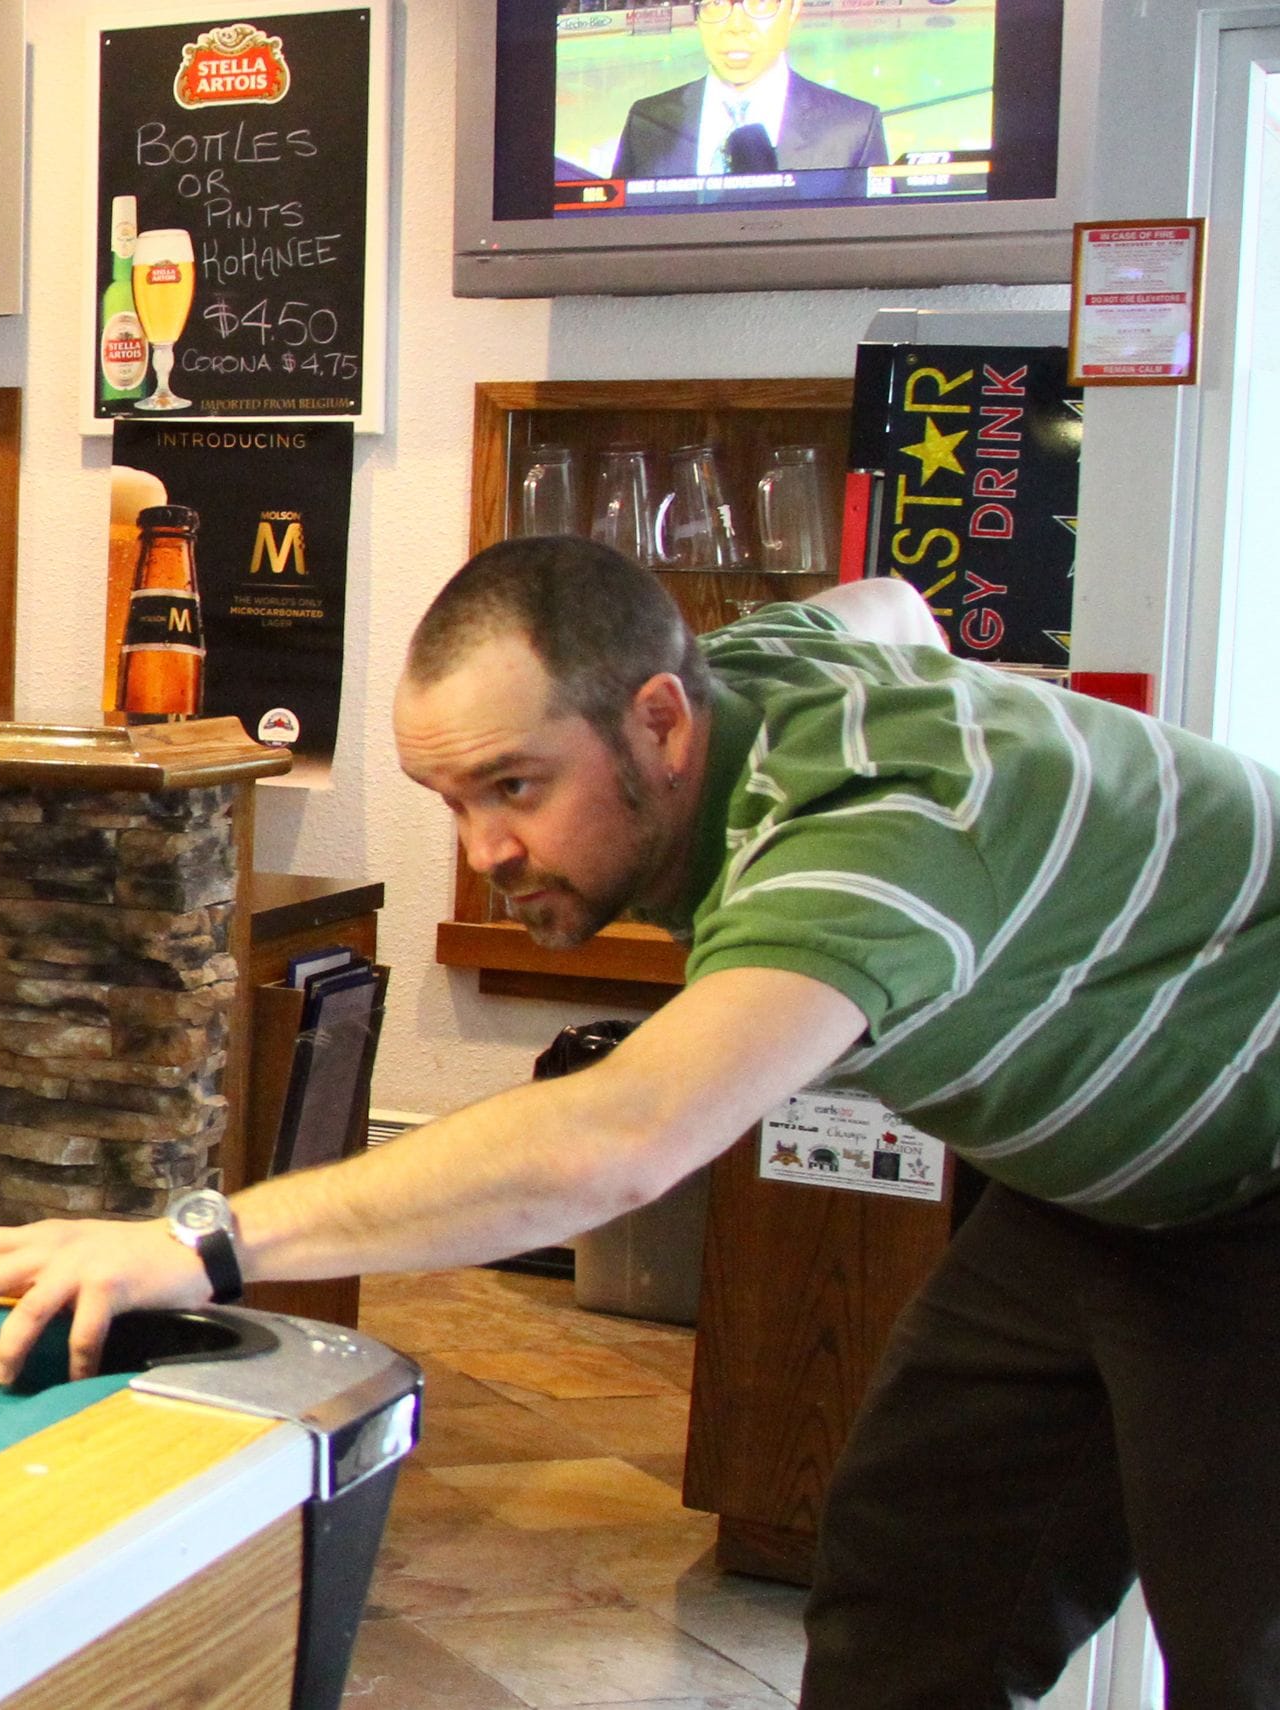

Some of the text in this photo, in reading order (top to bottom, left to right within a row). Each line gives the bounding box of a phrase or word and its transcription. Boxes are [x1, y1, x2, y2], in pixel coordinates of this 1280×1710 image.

[197, 57, 267, 77] STELLA
[196, 74, 268, 93] ARTOIS
[136, 121, 318, 166] BOTTLES
[178, 169, 230, 197] OR
[203, 198, 304, 229] PINTS
[1112, 232, 1138, 240] CASE
[1140, 231, 1152, 239] OF
[1154, 230, 1176, 239] FIRE
[203, 297, 338, 347] $4.50
[107, 341, 142, 351] STELLA
[107, 350, 142, 359] ARTOIS
[181, 349, 272, 375] CORONA
[1136, 365, 1163, 373] CALM
[200, 398, 347, 411] IMPORTED FROM BELGIUM
[156, 432, 308, 449] INTRODUCING
[968, 363, 1029, 540] DRINK
[260, 511, 302, 521] MOLSON
[249, 522, 307, 575] M
[233, 595, 323, 608] THE WORLD'S ONLY
[168, 607, 193, 634] M
[230, 606, 325, 618] MICROCARBONATED
[261, 618, 293, 628] LAGER
